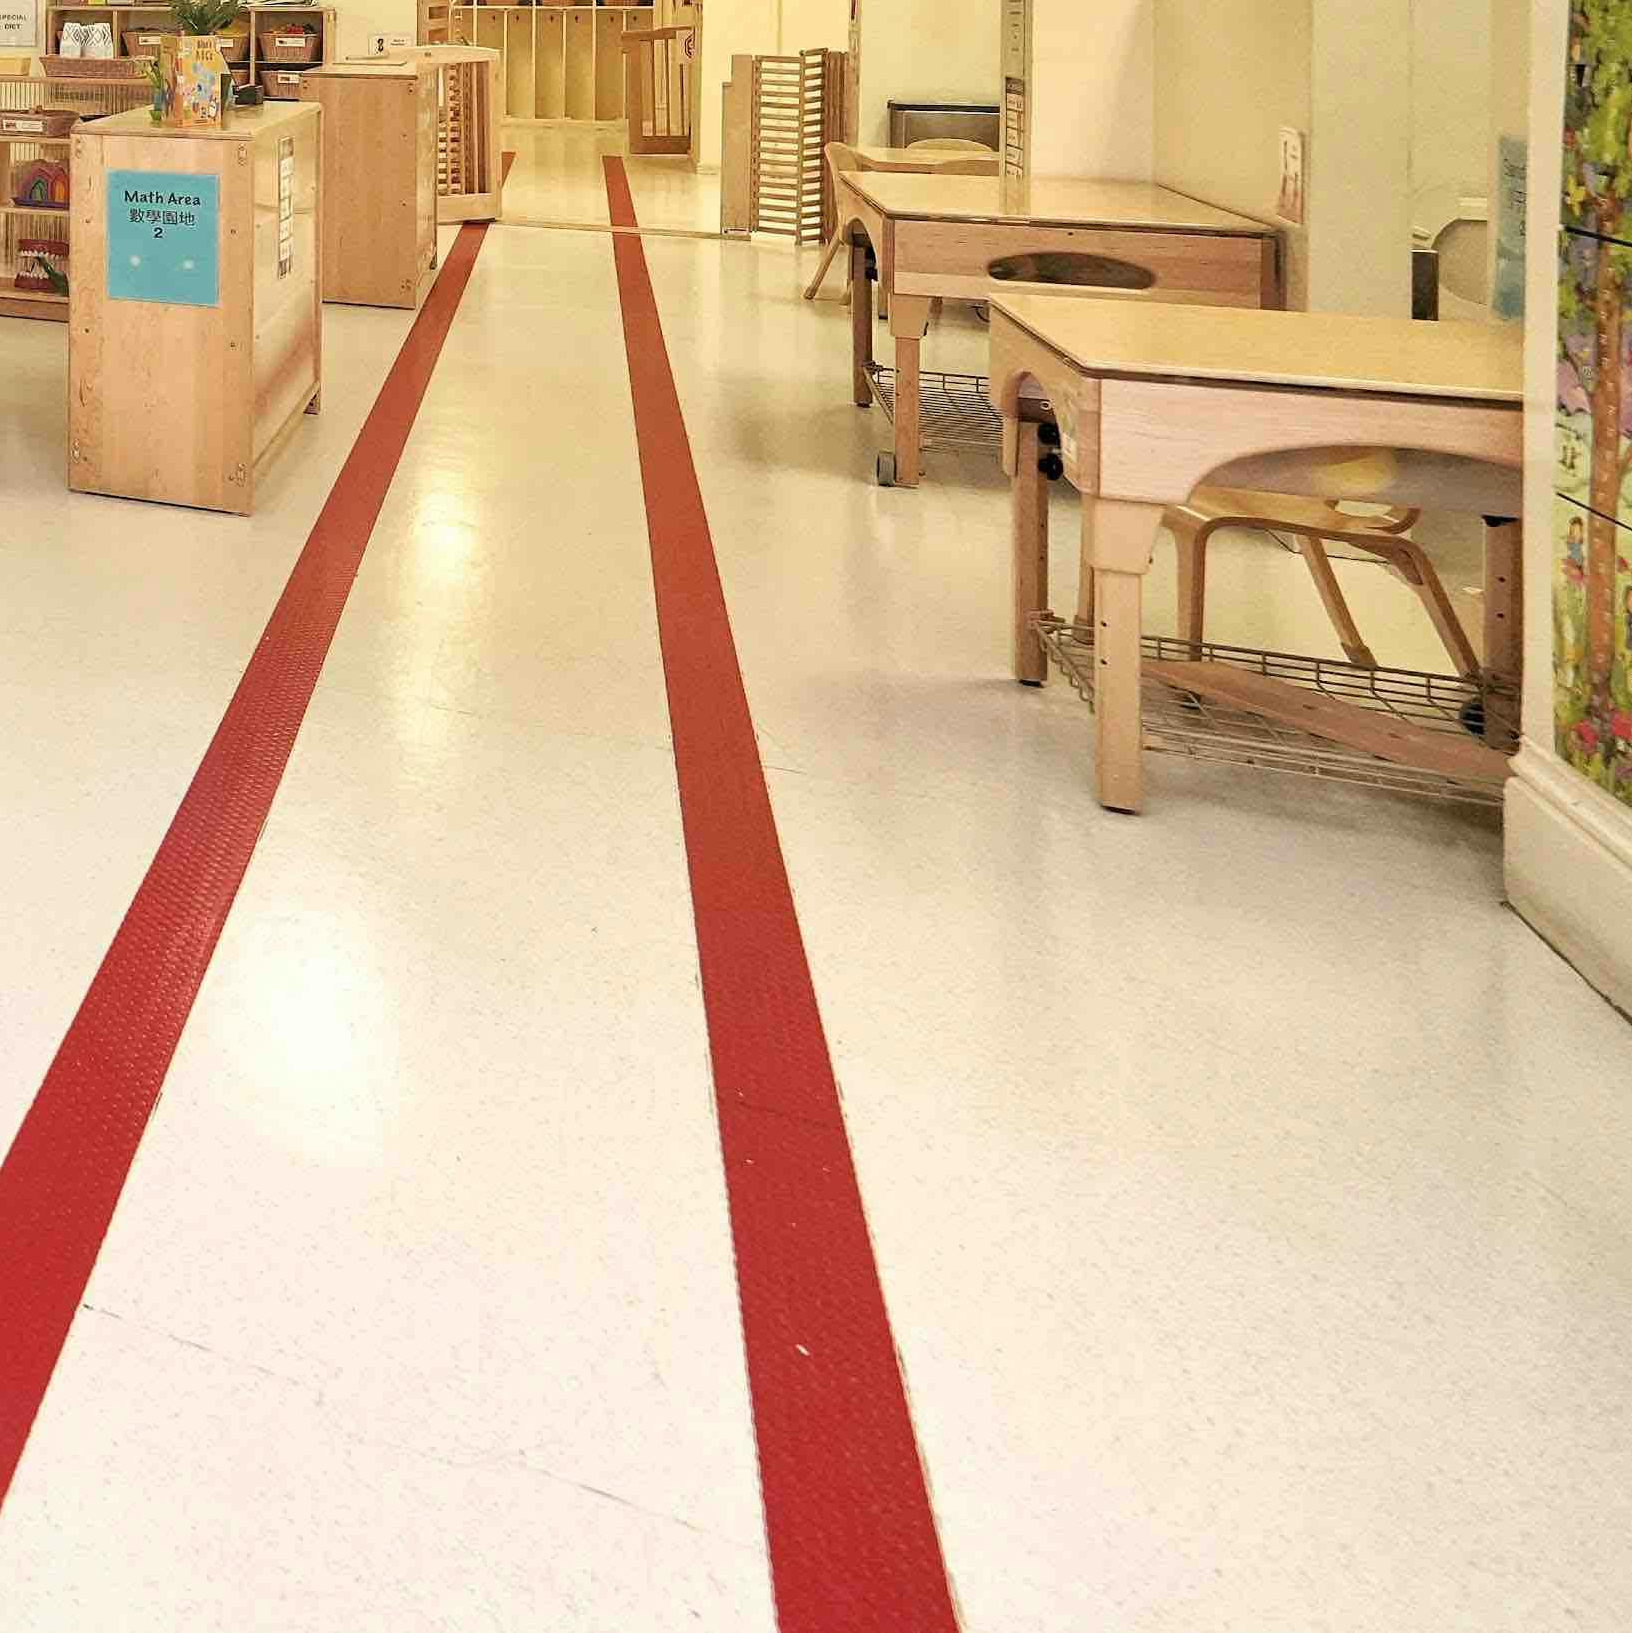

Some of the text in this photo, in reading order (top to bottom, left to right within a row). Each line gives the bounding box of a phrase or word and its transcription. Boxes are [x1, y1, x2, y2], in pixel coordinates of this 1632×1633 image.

[124, 190, 201, 206] Math Area
[129, 208, 196, 226] 數學園地
[154, 227, 163, 239] 2
